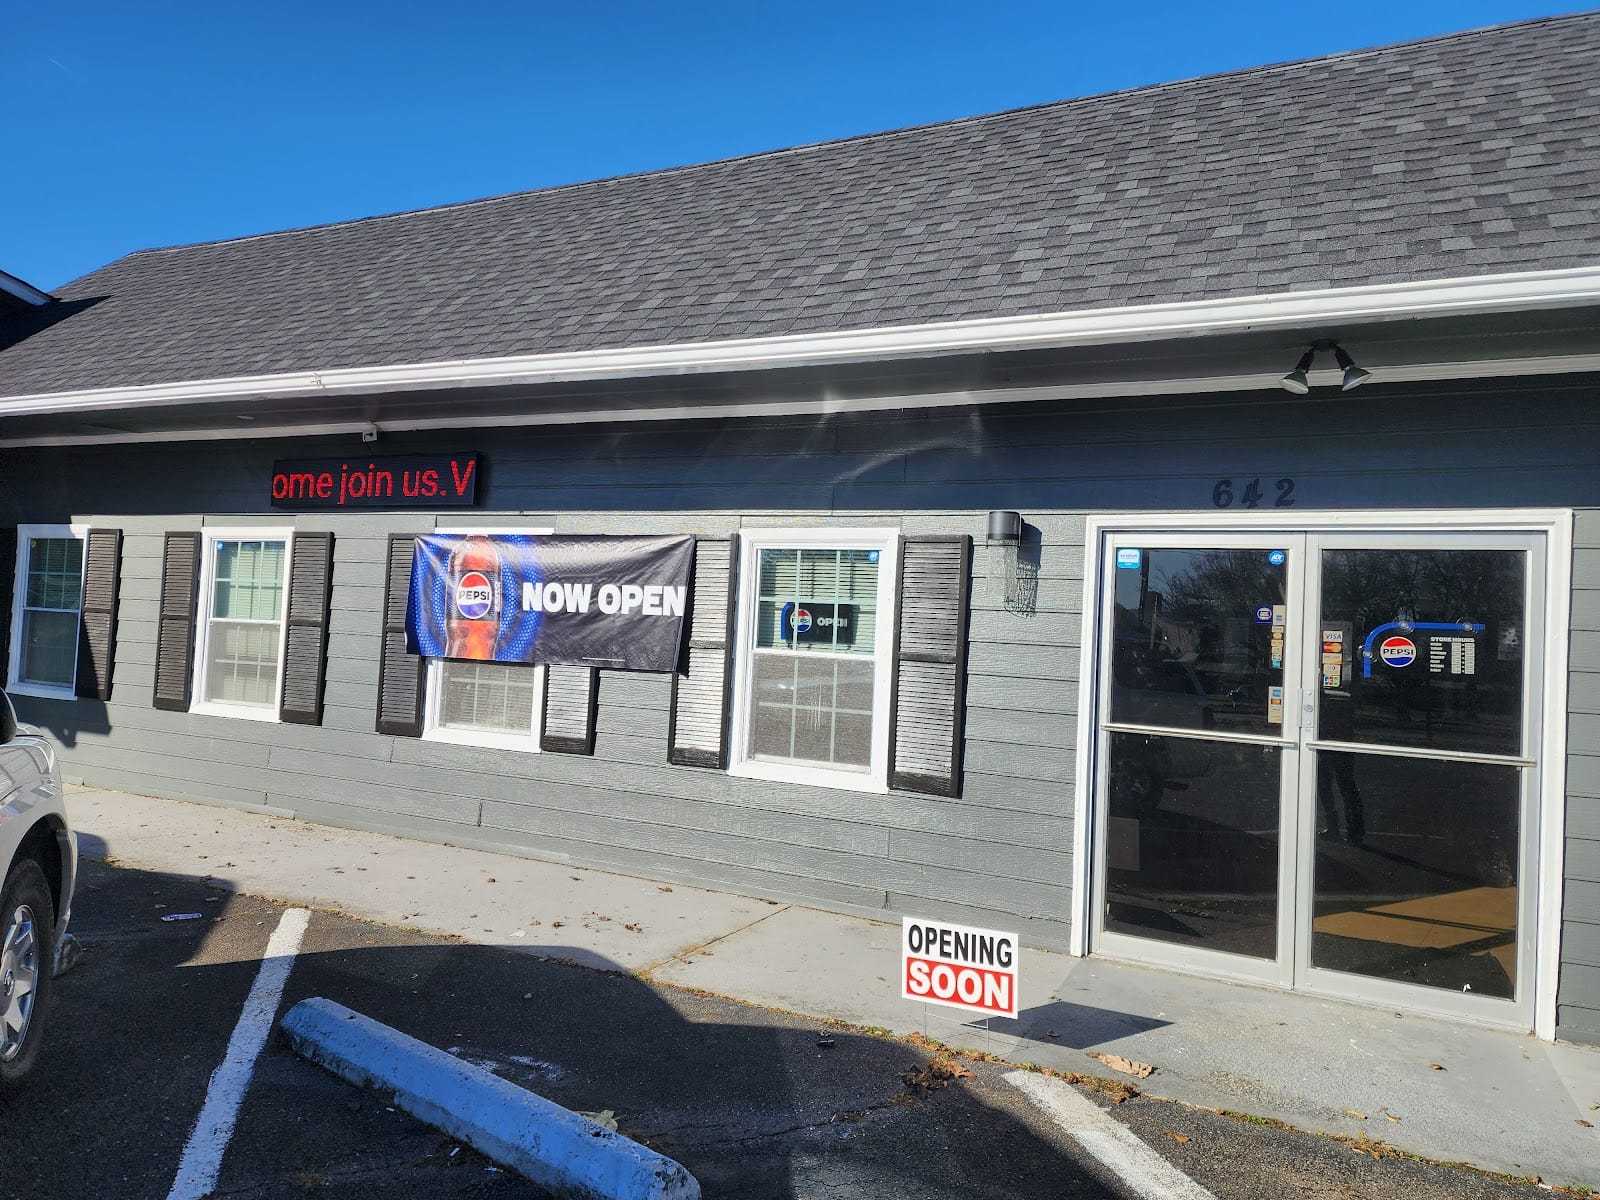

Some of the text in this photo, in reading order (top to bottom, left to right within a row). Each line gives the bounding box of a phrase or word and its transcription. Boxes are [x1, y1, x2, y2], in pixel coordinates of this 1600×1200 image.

[272, 459, 477, 505] ome join us. V
[1212, 478, 1296, 509] 642
[459, 590, 490, 601] PEPSI
[522, 582, 593, 613] NOW
[598, 584, 686, 617] OPEN
[1383, 648, 1414, 656] PEPSI
[908, 924, 1012, 969] OPENING
[908, 960, 1010, 1010] SOON
